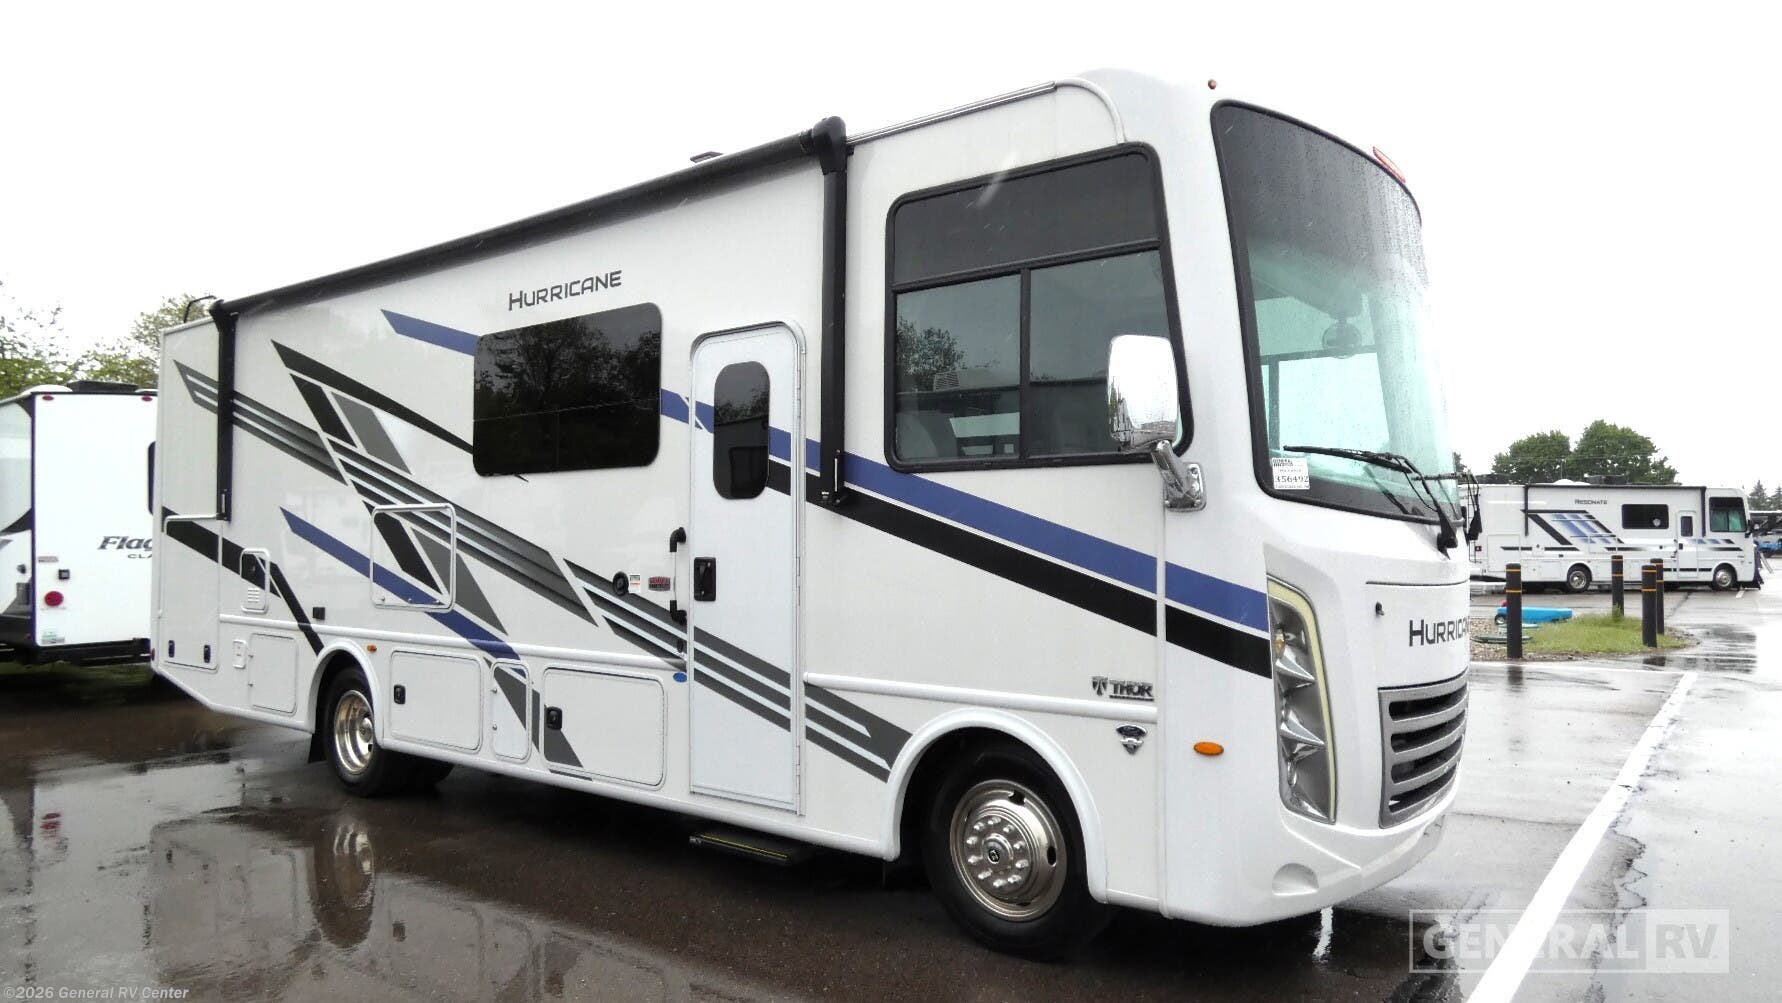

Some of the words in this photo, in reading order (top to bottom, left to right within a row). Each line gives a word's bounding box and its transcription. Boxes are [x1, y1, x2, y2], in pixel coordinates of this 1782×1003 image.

[508, 269, 623, 311] HURRICANE
[97, 535, 153, 552] Flag
[1109, 680, 1154, 698] THOR
